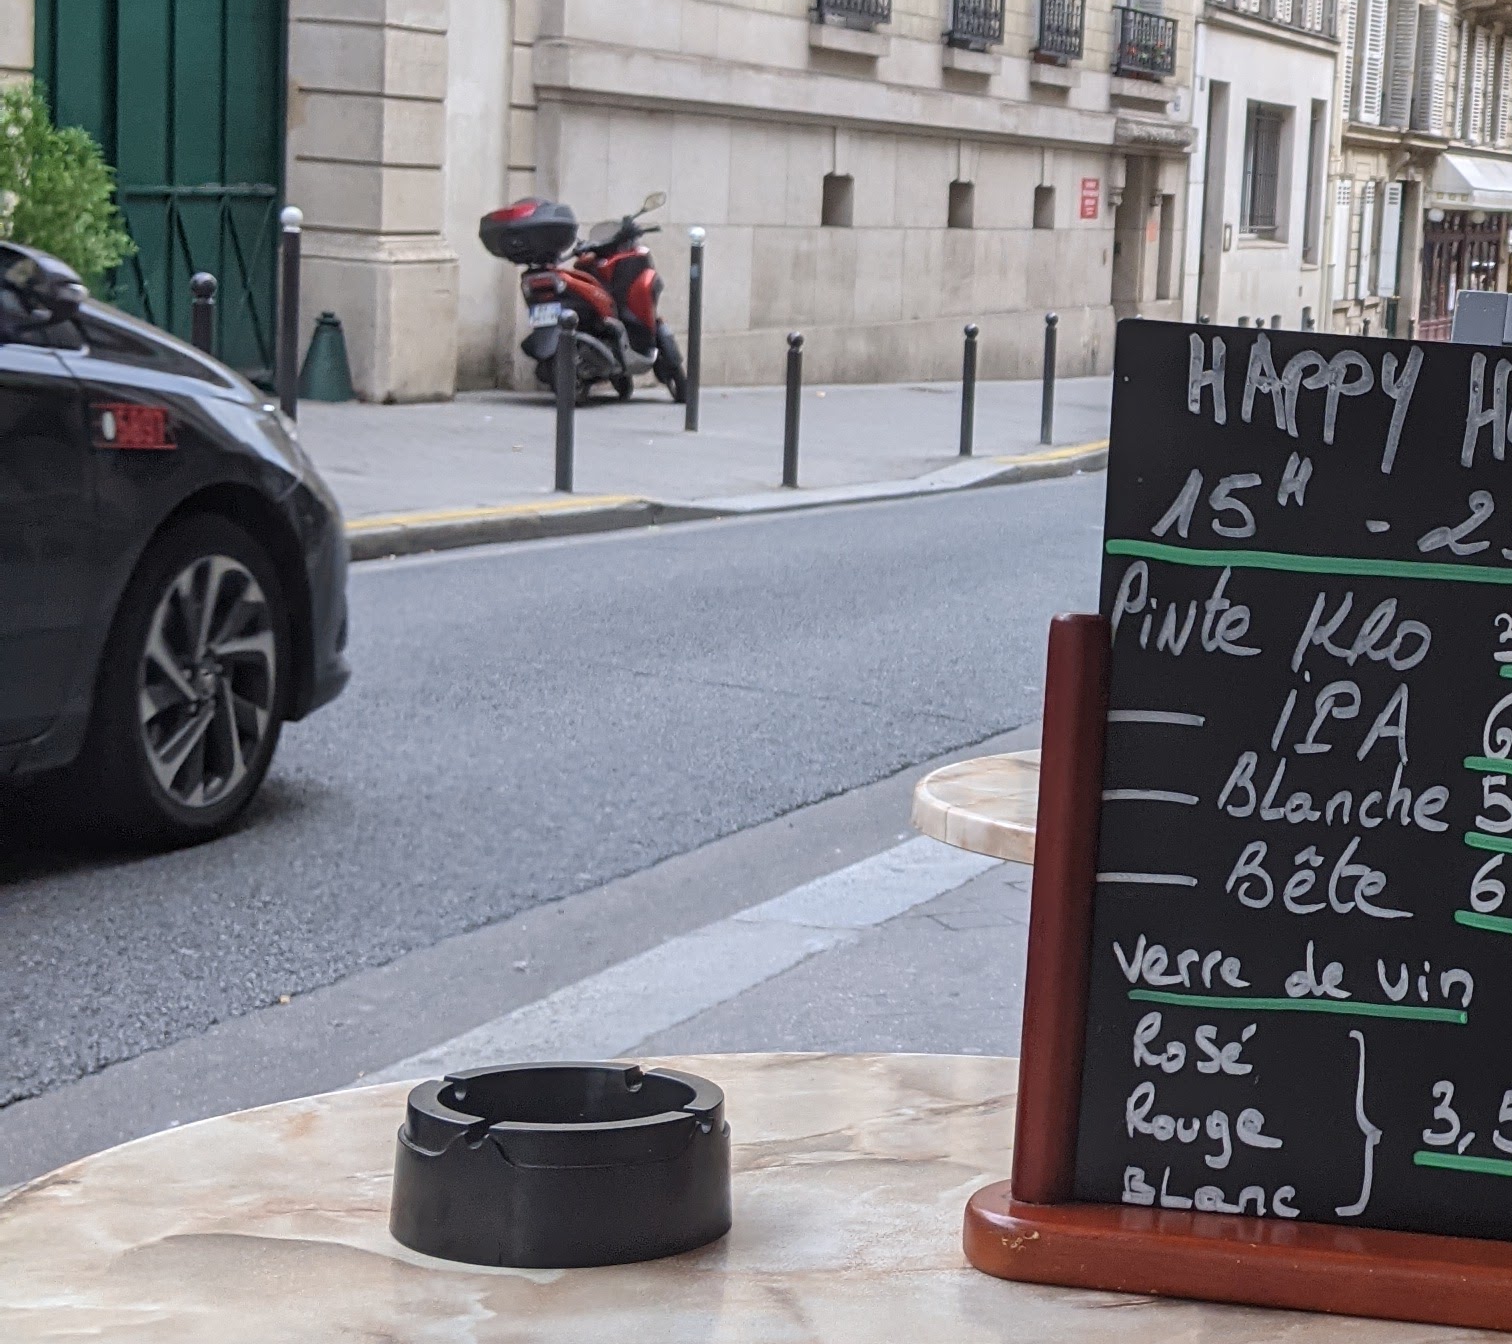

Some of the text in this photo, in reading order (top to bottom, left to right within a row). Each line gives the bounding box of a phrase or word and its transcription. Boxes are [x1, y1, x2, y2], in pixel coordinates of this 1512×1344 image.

[1187, 332, 1422, 474] HAPPY
[1285, 940, 1351, 998] de
[1126, 1082, 1283, 1169] Rouge
